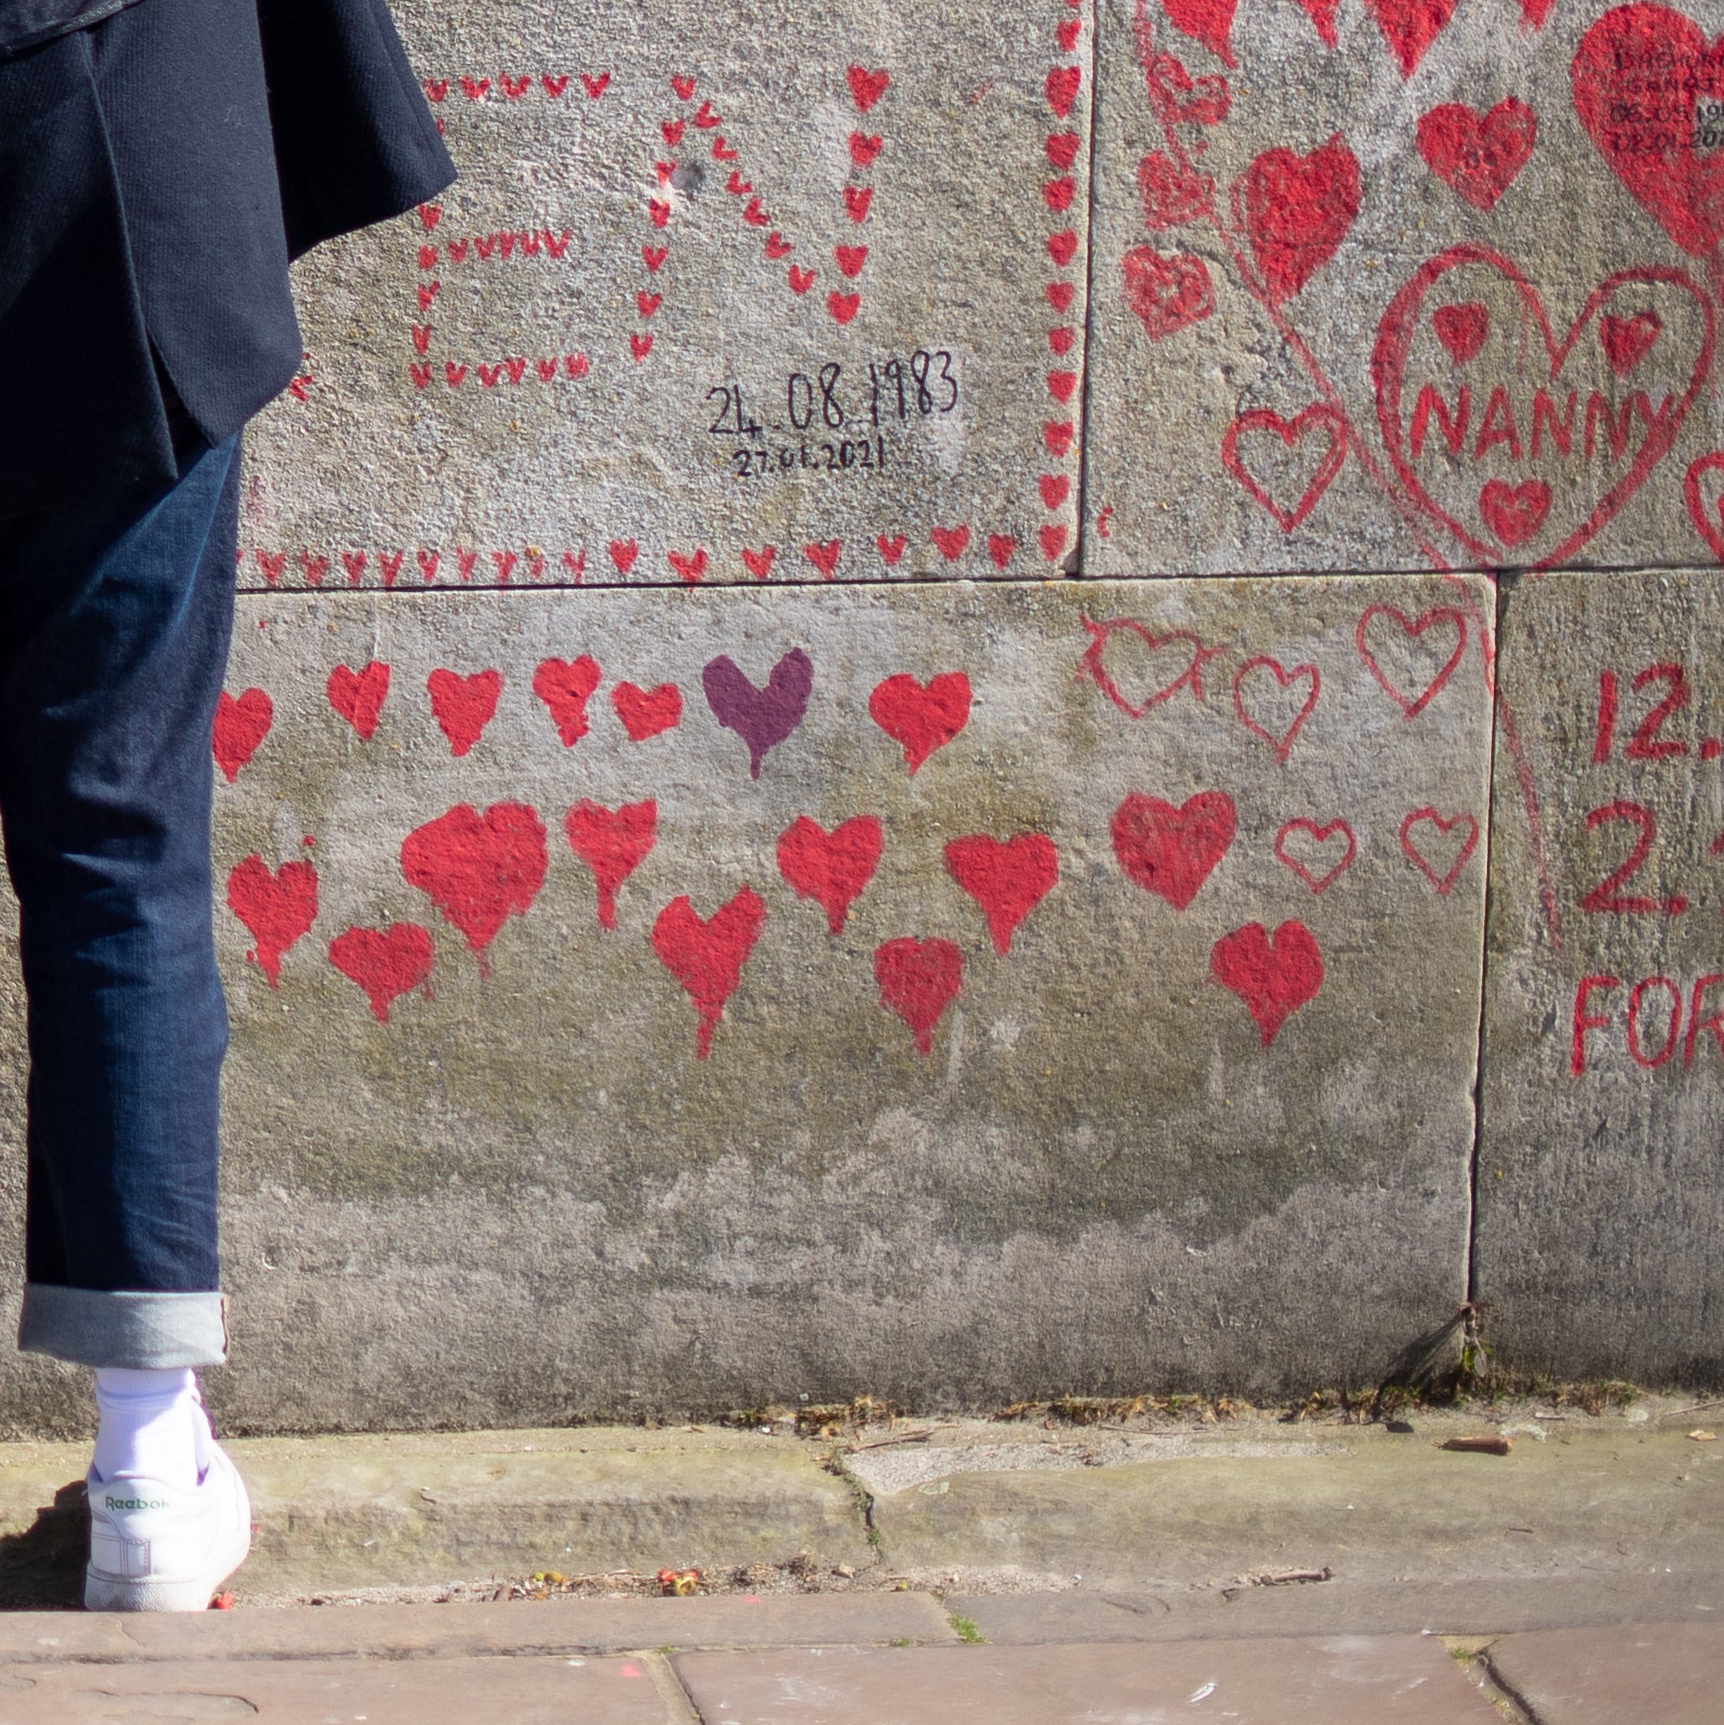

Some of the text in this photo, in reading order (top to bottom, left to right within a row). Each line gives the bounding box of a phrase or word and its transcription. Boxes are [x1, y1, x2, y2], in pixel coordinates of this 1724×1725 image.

[1409, 385, 1679, 460] NANNY
[735, 437, 887, 478] 27.01.2021
[104, 1494, 172, 1512] Reebok
